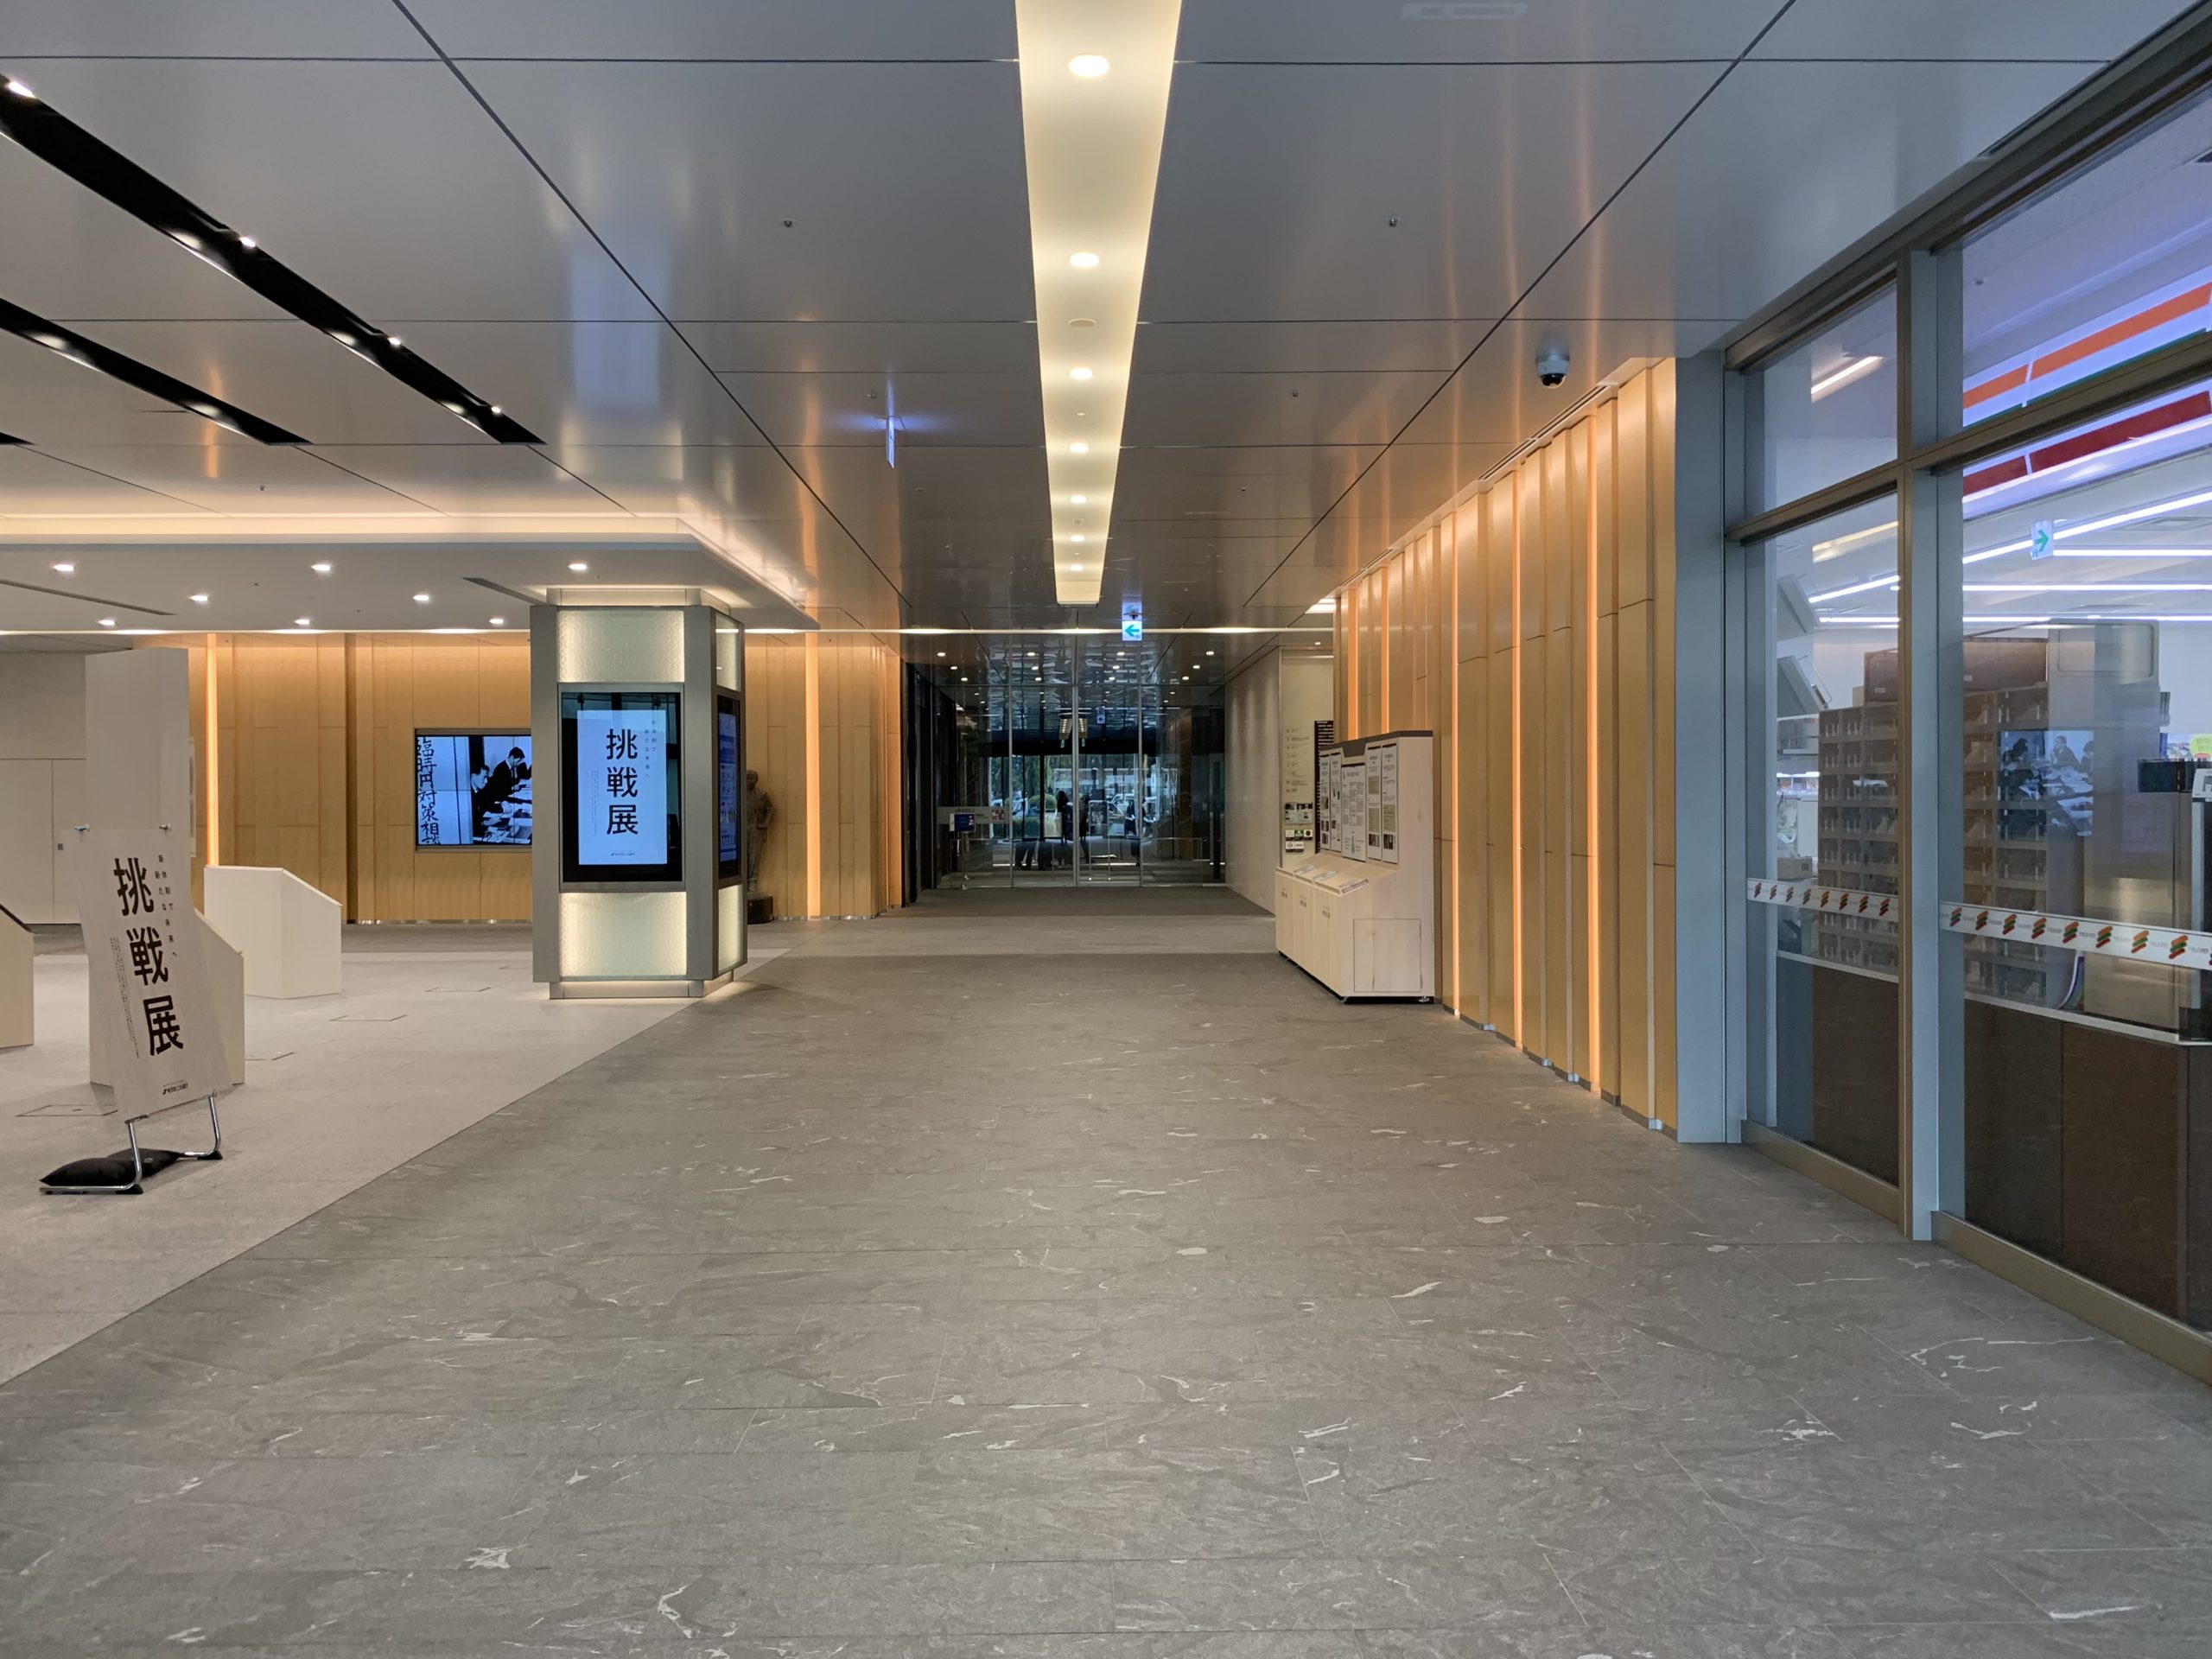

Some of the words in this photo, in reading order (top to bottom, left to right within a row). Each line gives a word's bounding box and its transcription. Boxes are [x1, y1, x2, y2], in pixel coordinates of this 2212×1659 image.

[607, 728, 638, 835] 挑戦展
[114, 857, 184, 1056] 挑戦展
